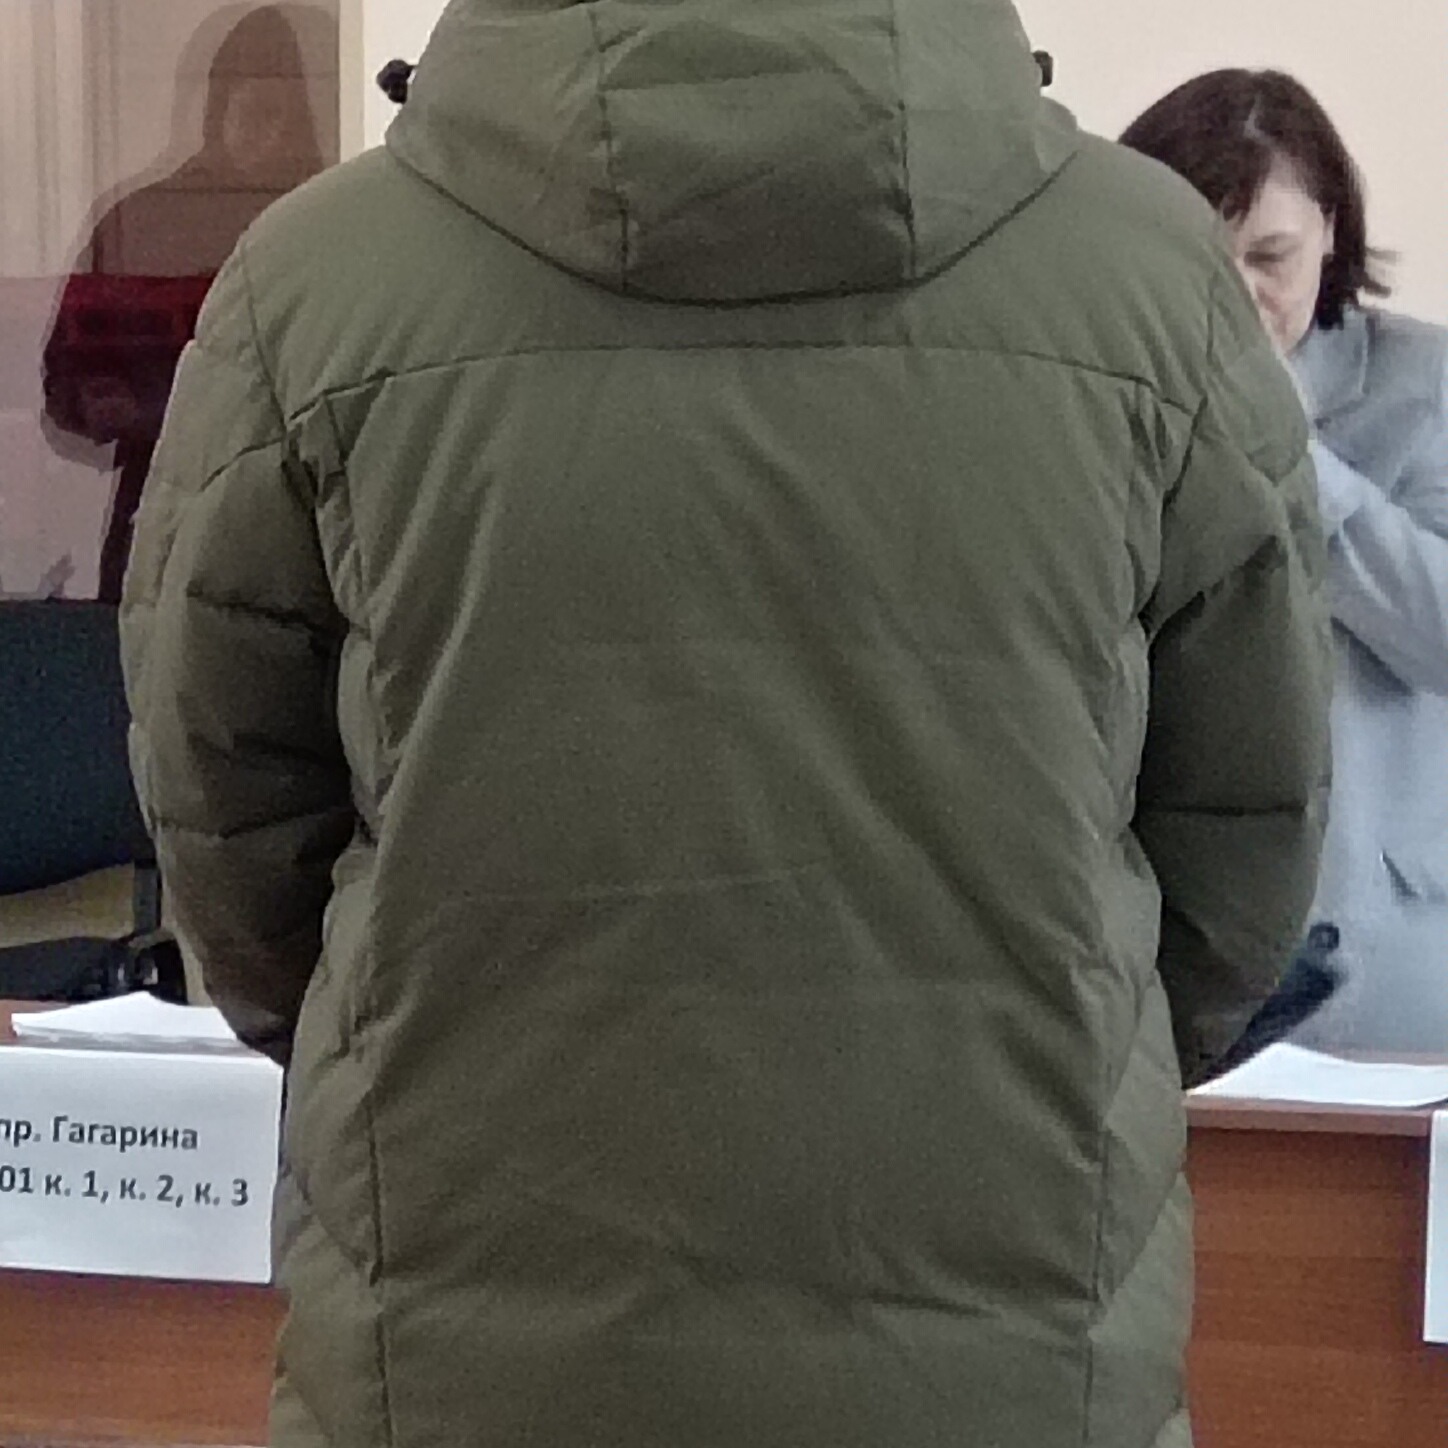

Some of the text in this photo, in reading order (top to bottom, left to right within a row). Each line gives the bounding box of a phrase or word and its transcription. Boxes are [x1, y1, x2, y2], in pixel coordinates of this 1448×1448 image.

[52, 1114, 198, 1154] Гагарина
[44, 1173, 71, 1197] к.
[81, 1169, 109, 1204] 1,
[119, 1177, 147, 1201] к.
[156, 1173, 184, 1209] 2,
[194, 1182, 221, 1207] к.
[231, 1178, 249, 1207] 3
